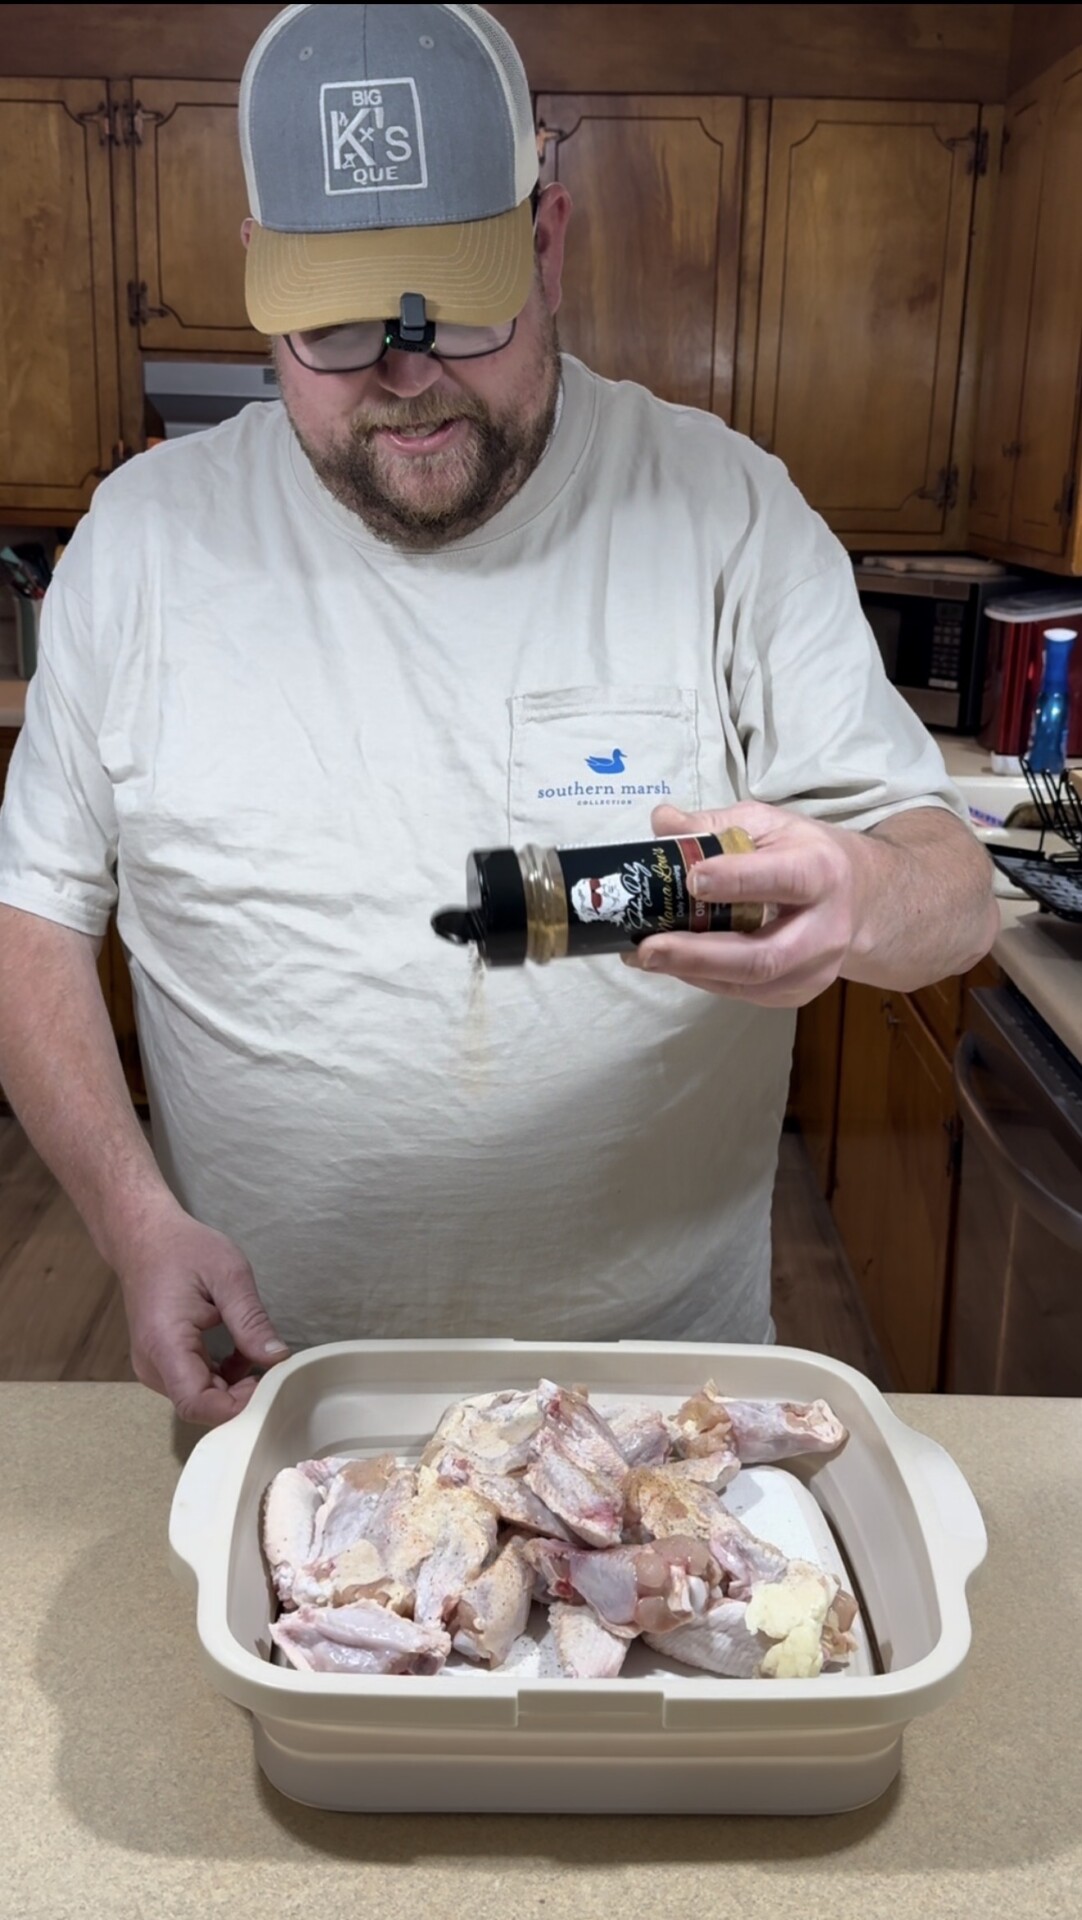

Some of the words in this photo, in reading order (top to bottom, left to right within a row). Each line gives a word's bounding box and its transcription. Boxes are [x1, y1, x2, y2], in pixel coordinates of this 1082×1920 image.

[352, 88, 382, 106] BIG
[353, 166, 399, 185] QUE
[537, 781, 614, 799] southern
[621, 780, 671, 795] marsh
[652, 847, 672, 882] Lou's
[656, 885, 675, 932] Mama
